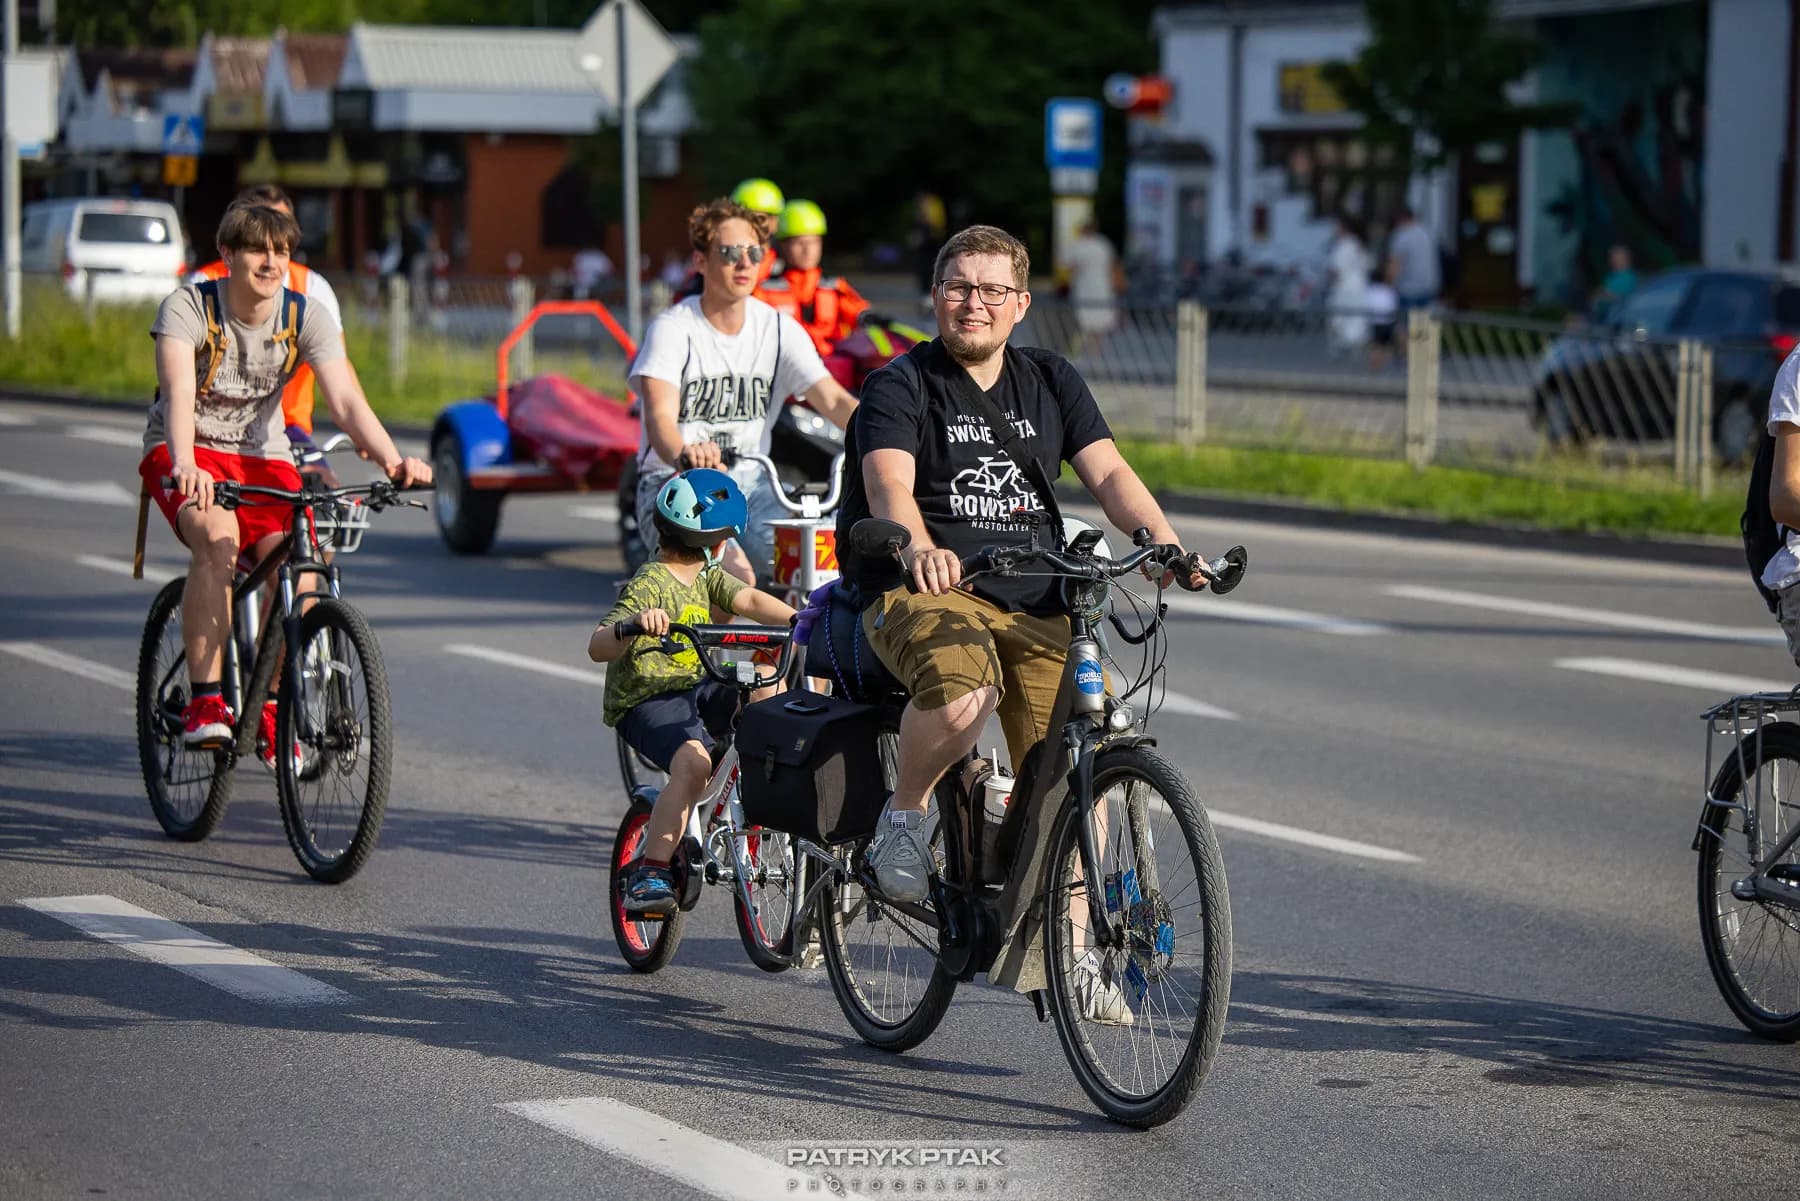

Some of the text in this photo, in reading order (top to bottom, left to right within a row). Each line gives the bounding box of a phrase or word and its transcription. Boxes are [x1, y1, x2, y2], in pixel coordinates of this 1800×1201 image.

[1001, 409, 1016, 420] UŻ
[947, 418, 1037, 444] SWOJE TA
[949, 492, 1045, 517] ROWERZE
